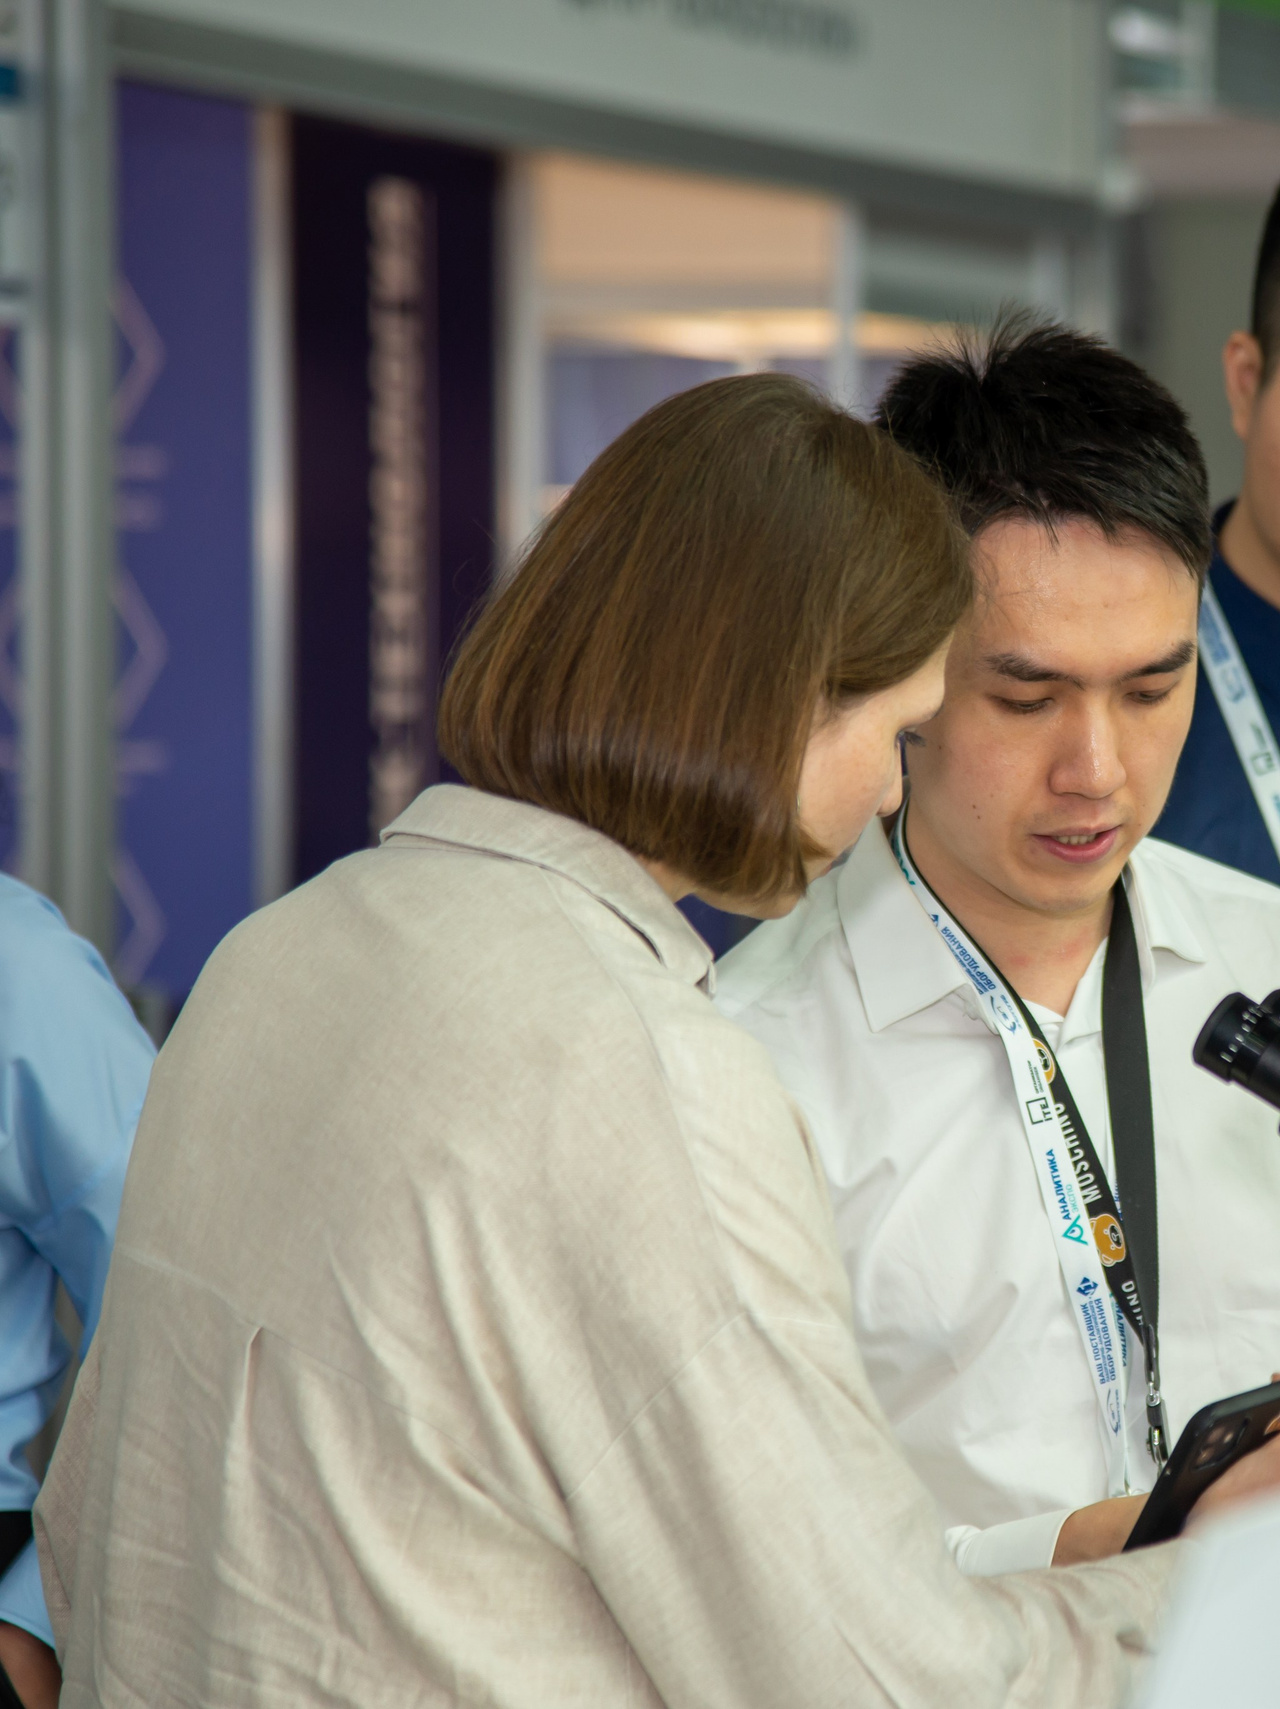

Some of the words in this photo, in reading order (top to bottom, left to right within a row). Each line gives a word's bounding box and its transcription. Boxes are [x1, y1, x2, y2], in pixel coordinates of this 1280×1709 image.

[941, 926, 996, 990] ОБОРУДОВАНИЯ
[1045, 1148, 1072, 1221] АНАЛИТИКА
[1065, 1183, 1079, 1214] ЭКСПО
[1080, 1303, 1101, 1361] ПОСТАВЩИК
[1094, 1298, 1116, 1381] ОБОРУДОВАНИЯ
[1096, 1363, 1106, 1385] ВАШ
